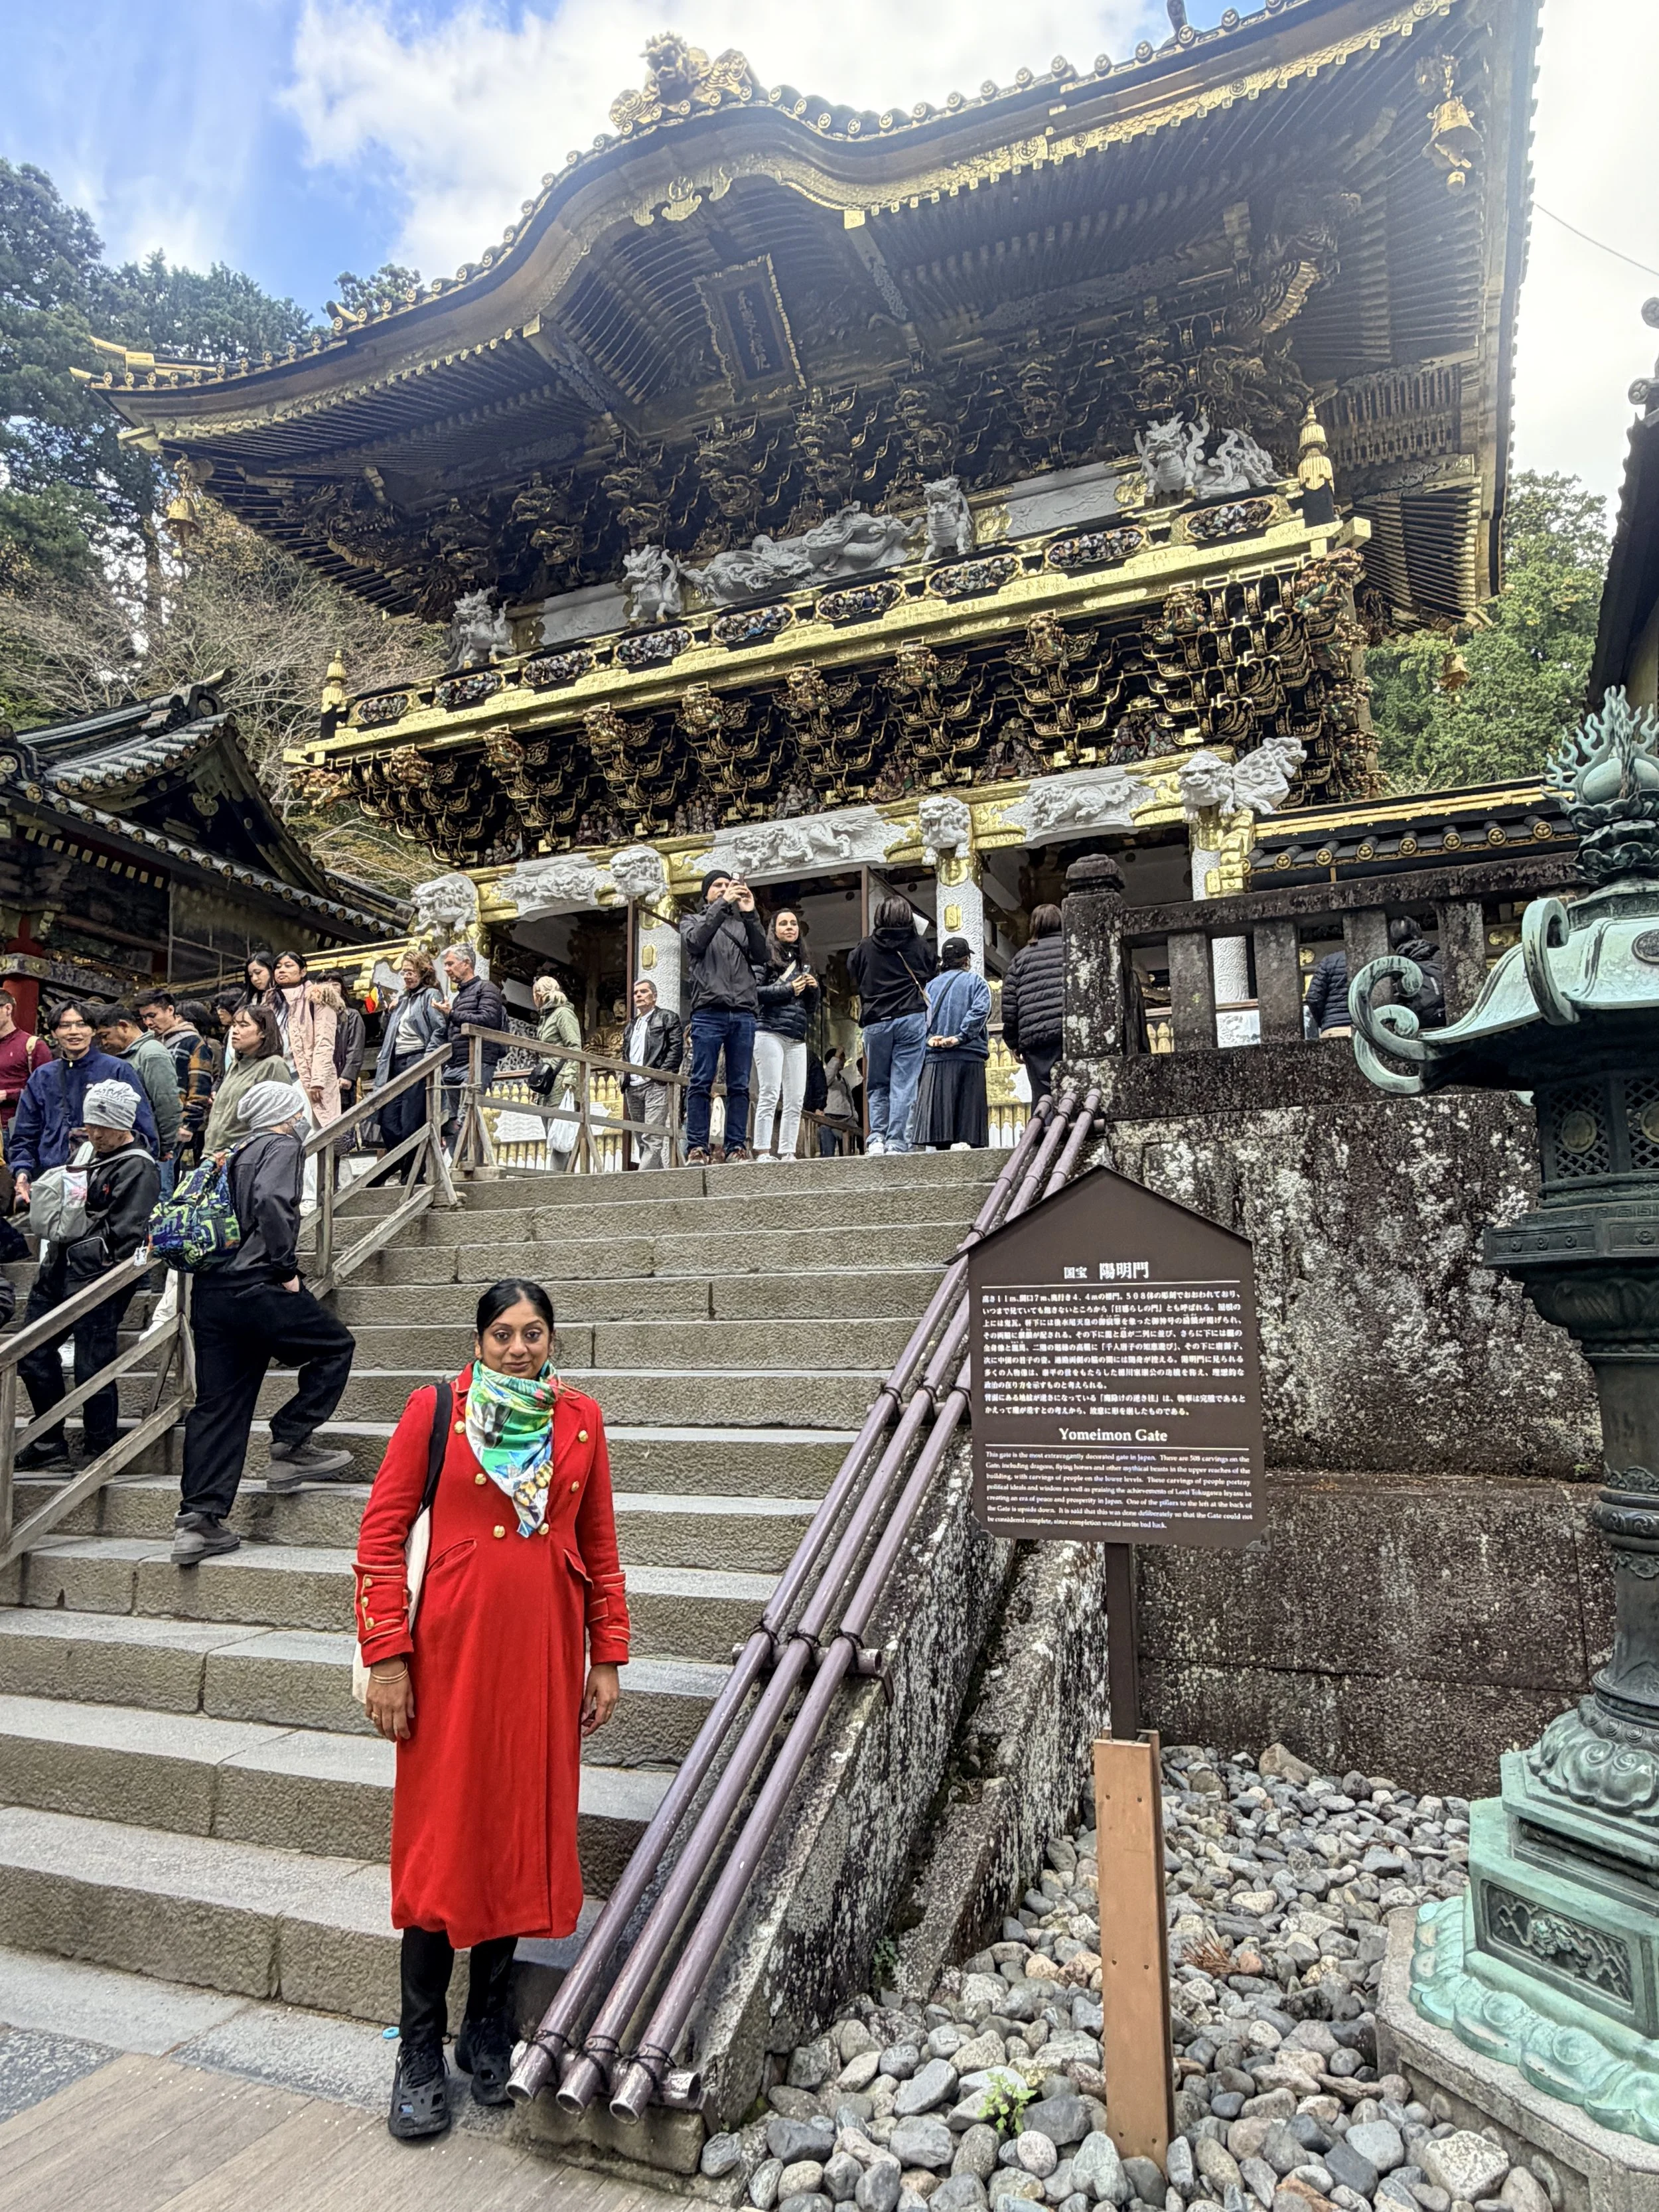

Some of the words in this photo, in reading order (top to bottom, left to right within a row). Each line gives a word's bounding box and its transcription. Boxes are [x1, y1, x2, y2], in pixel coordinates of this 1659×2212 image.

[1064, 1266, 1088, 1279] 国宝
[1100, 1261, 1149, 1280] 陽明門
[1058, 1428, 1132, 1442] Yomeimon
[1135, 1428, 1168, 1442] Gate
[1054, 1463, 1073, 1471] flying
[1062, 1474, 1084, 1483] people
[1202, 1477, 1225, 1486] people
[1190, 1489, 1222, 1497] Tokugawa
[1159, 1499, 1179, 1507] pillars
[1017, 1505, 1037, 1514] upside
